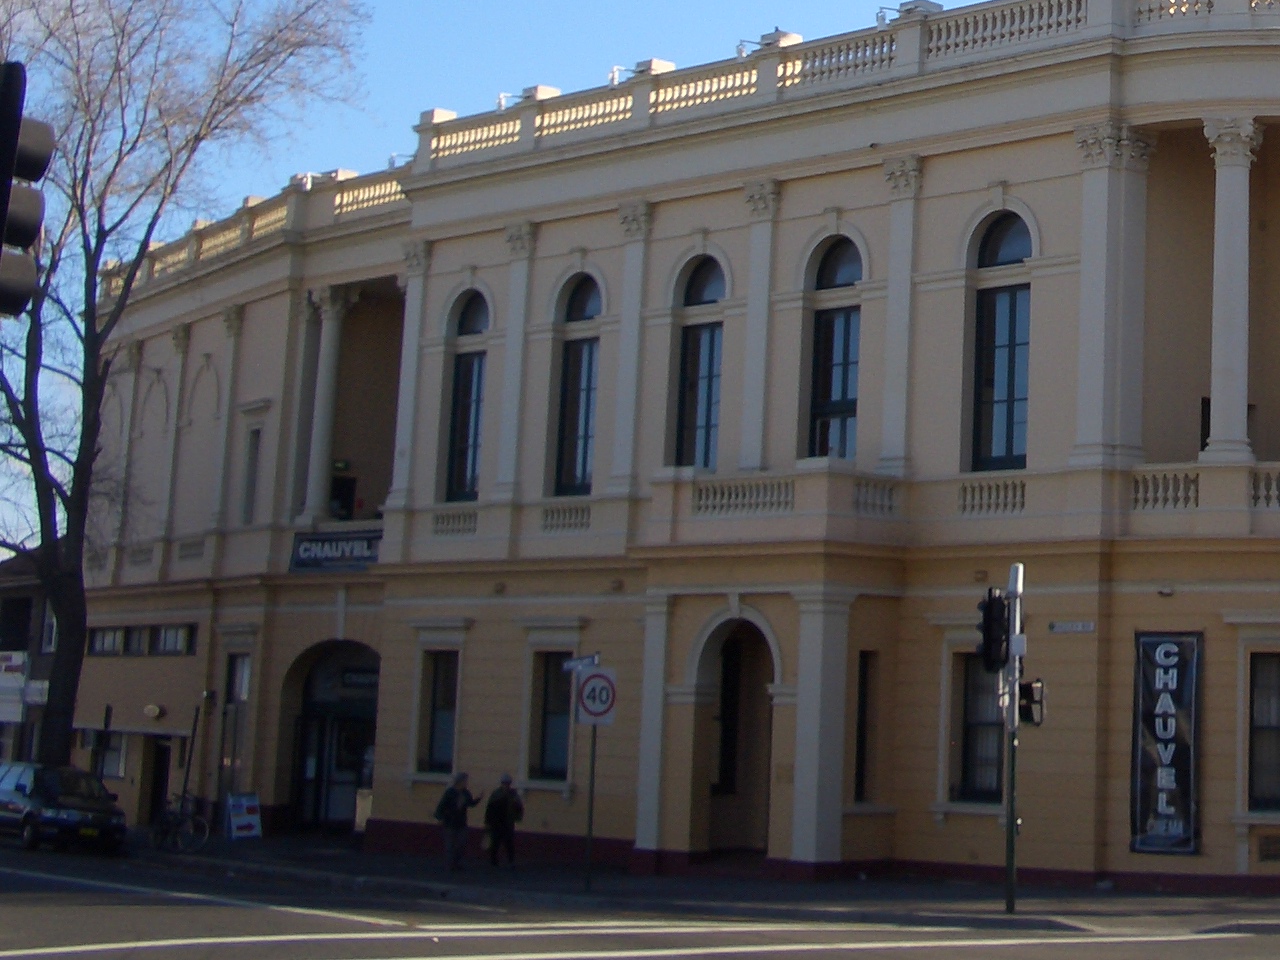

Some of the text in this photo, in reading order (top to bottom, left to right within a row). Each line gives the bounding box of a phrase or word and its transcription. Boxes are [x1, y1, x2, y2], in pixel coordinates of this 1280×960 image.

[299, 540, 371, 559] CHAUVEL
[586, 685, 610, 705] 40
[1154, 642, 1179, 815] CHAUVEL
